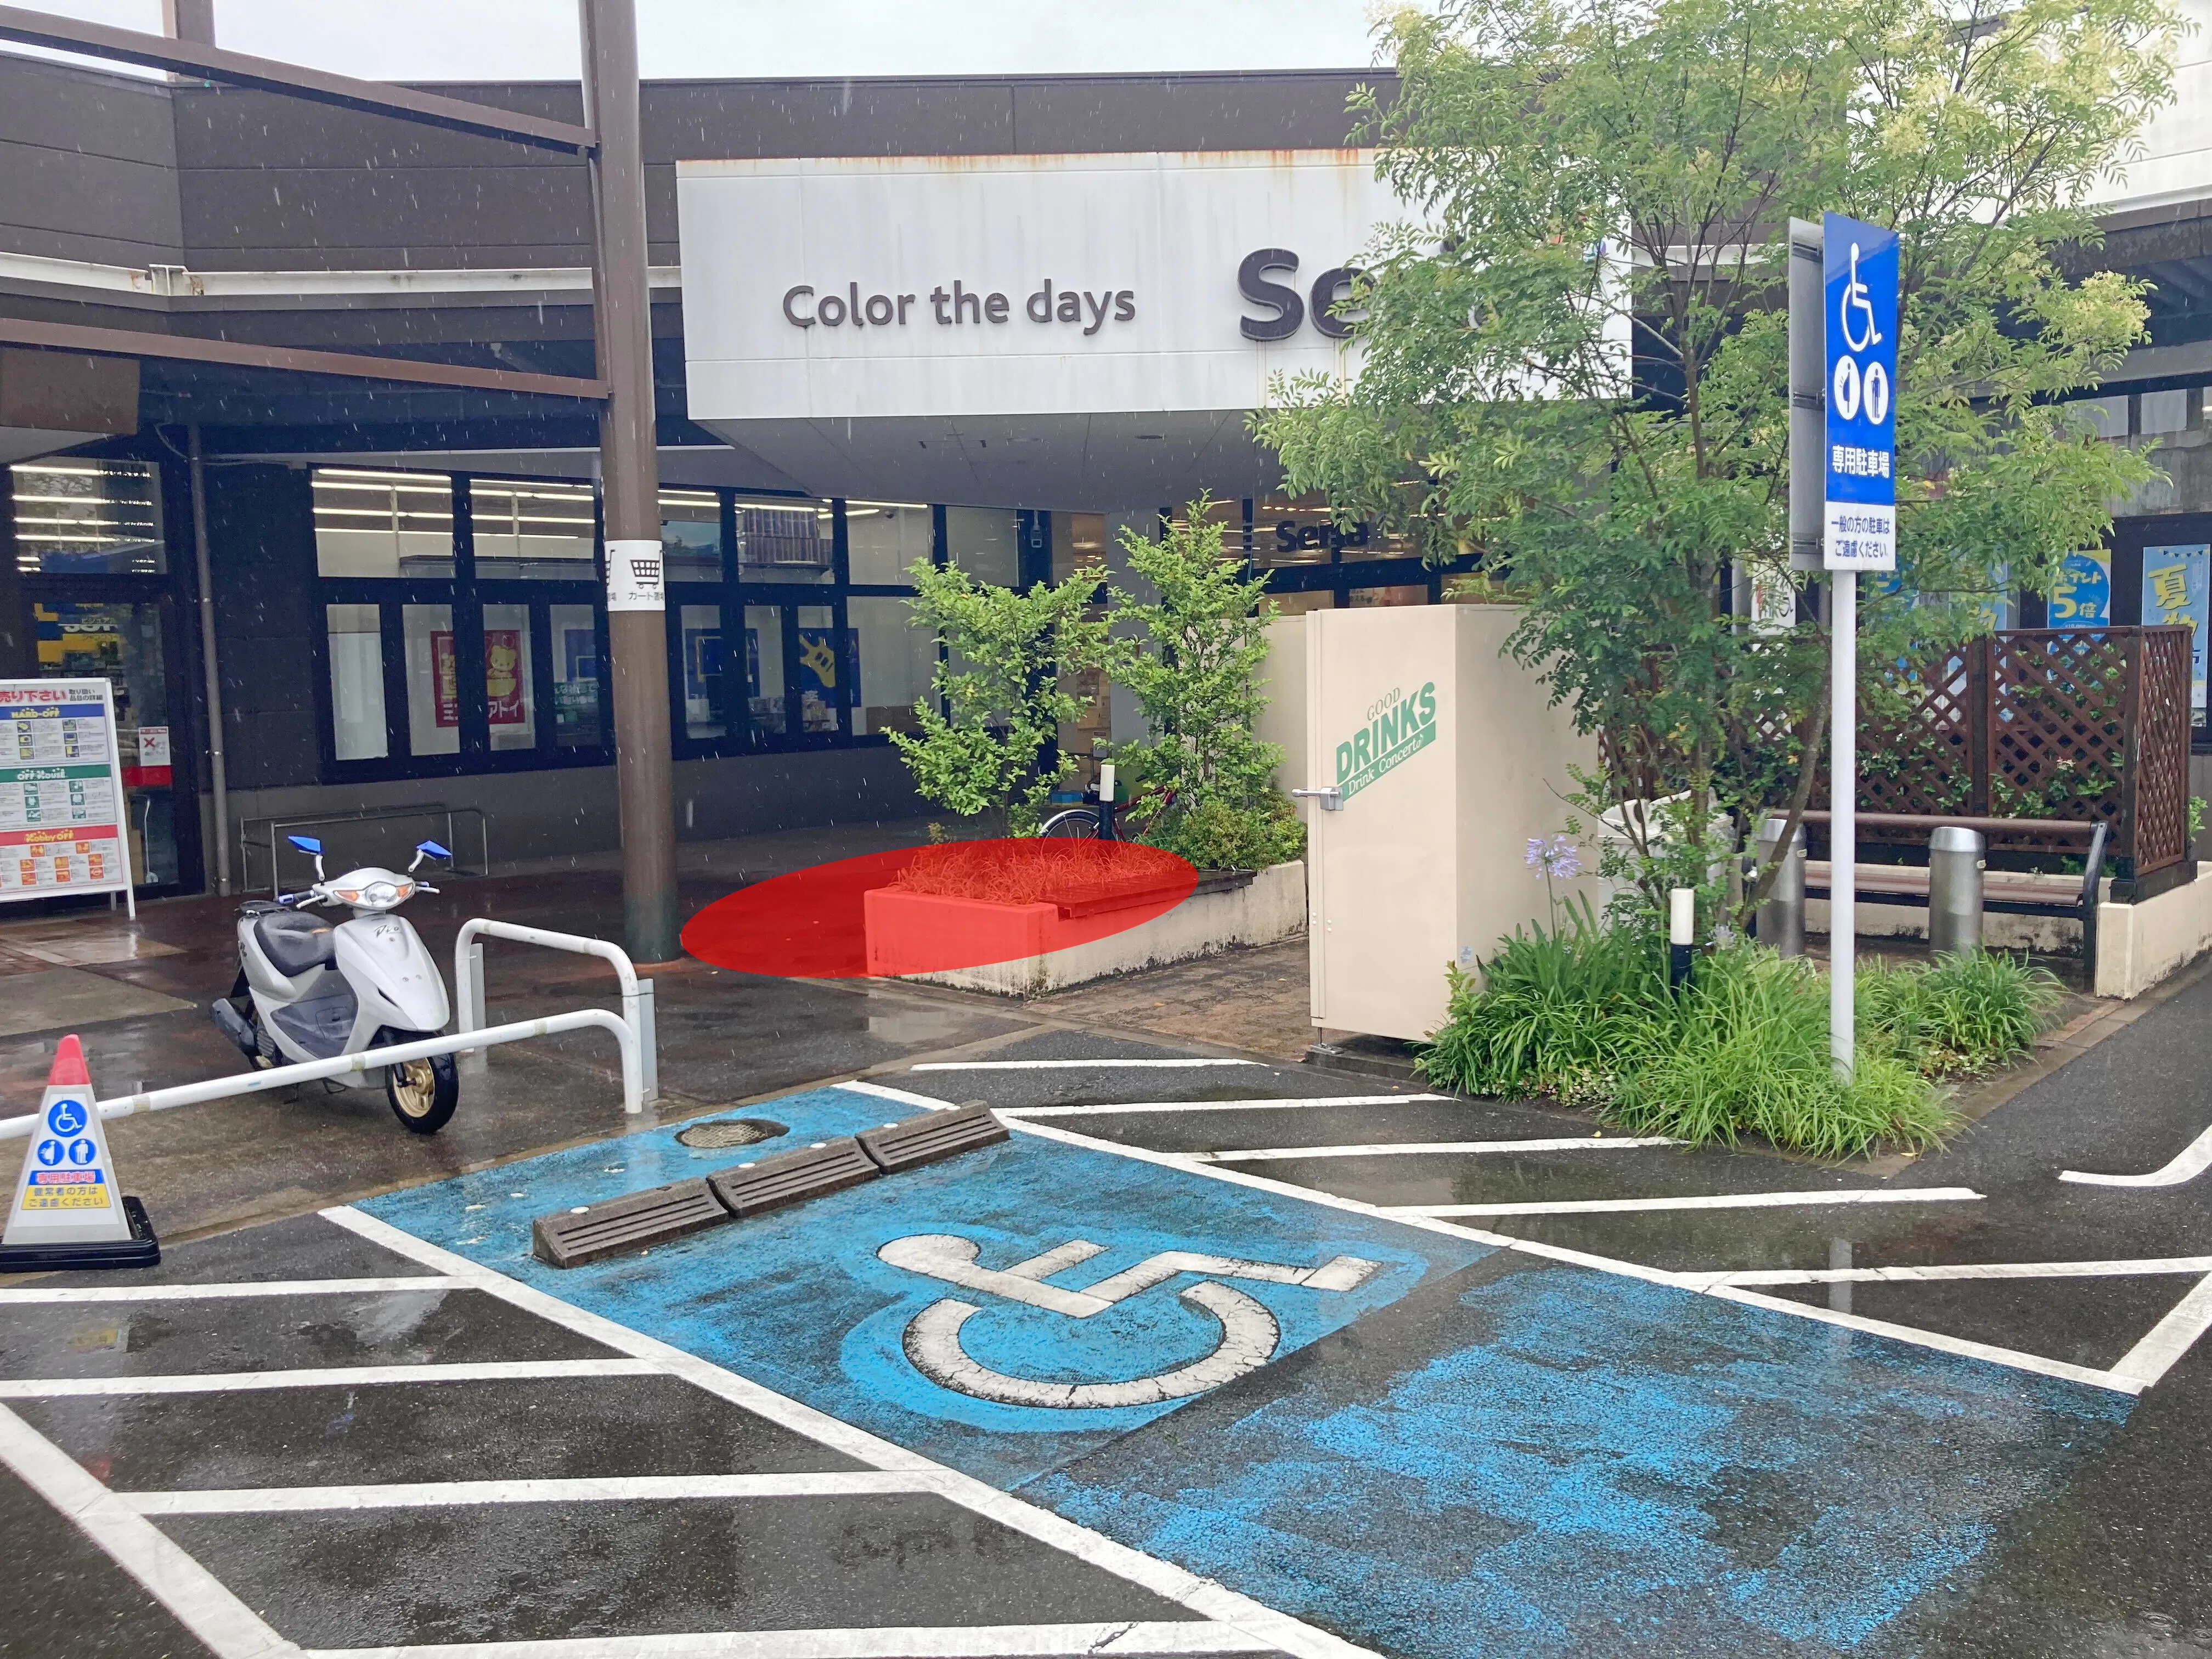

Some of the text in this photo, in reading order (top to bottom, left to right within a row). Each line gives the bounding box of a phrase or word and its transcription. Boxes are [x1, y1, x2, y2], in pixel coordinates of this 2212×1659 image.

[783, 279, 1136, 335] Color the days
[1832, 444, 1890, 479] 専用駐車場
[1831, 515, 1890, 534] 一般の方の駐車は
[1835, 540, 1887, 557] ご遠慮ください
[1367, 687, 1400, 721] GOOD
[1336, 682, 1436, 785] DRINKS
[1348, 733, 1424, 795] Drink Concerto
[36, 1172, 95, 1184] 専用駐車場
